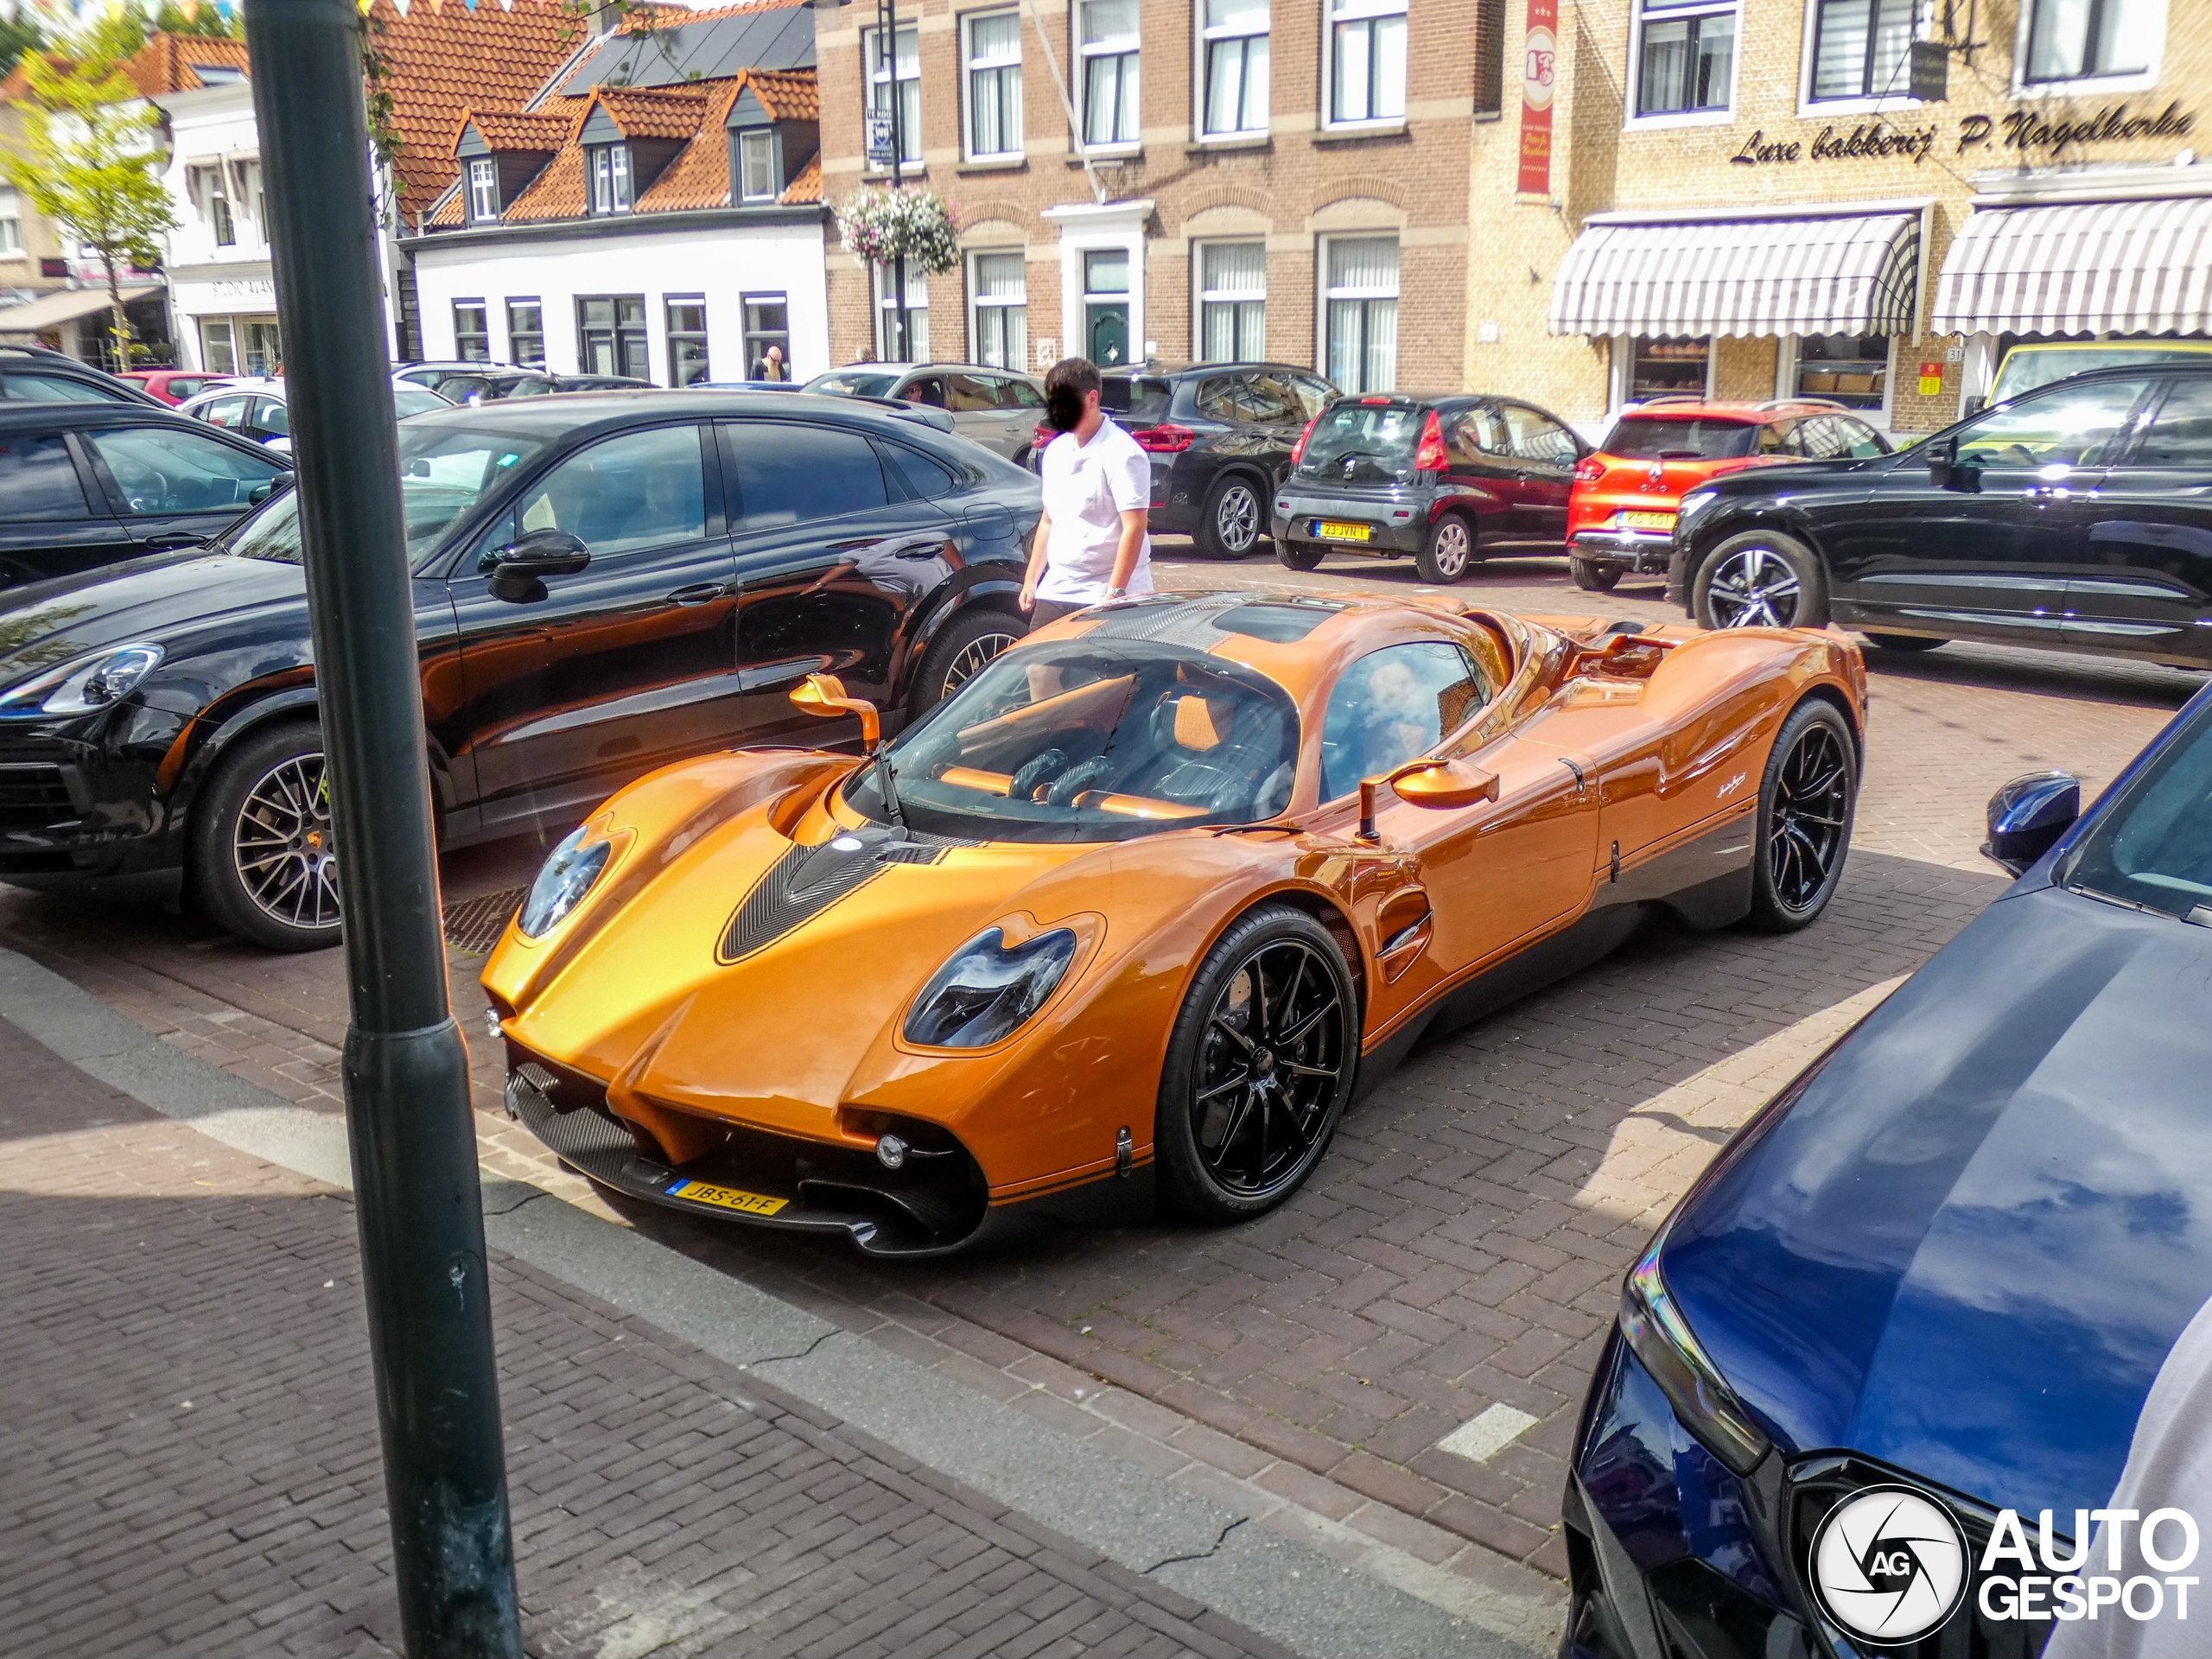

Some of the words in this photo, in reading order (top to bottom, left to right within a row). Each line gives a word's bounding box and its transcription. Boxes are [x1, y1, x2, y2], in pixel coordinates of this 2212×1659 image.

[877, 110, 892, 118] KOO
[1730, 130, 1800, 163] Luxe
[1811, 123, 1936, 164] bakkerij
[1956, 114, 1991, 153] P.
[2001, 100, 2195, 156] Nagelkerke
[248, 279, 275, 294] AVAN
[1948, 349, 1961, 360] 31
[1325, 524, 1364, 537] 23-JVN-1
[688, 1186, 775, 1210] JBS-61-F
